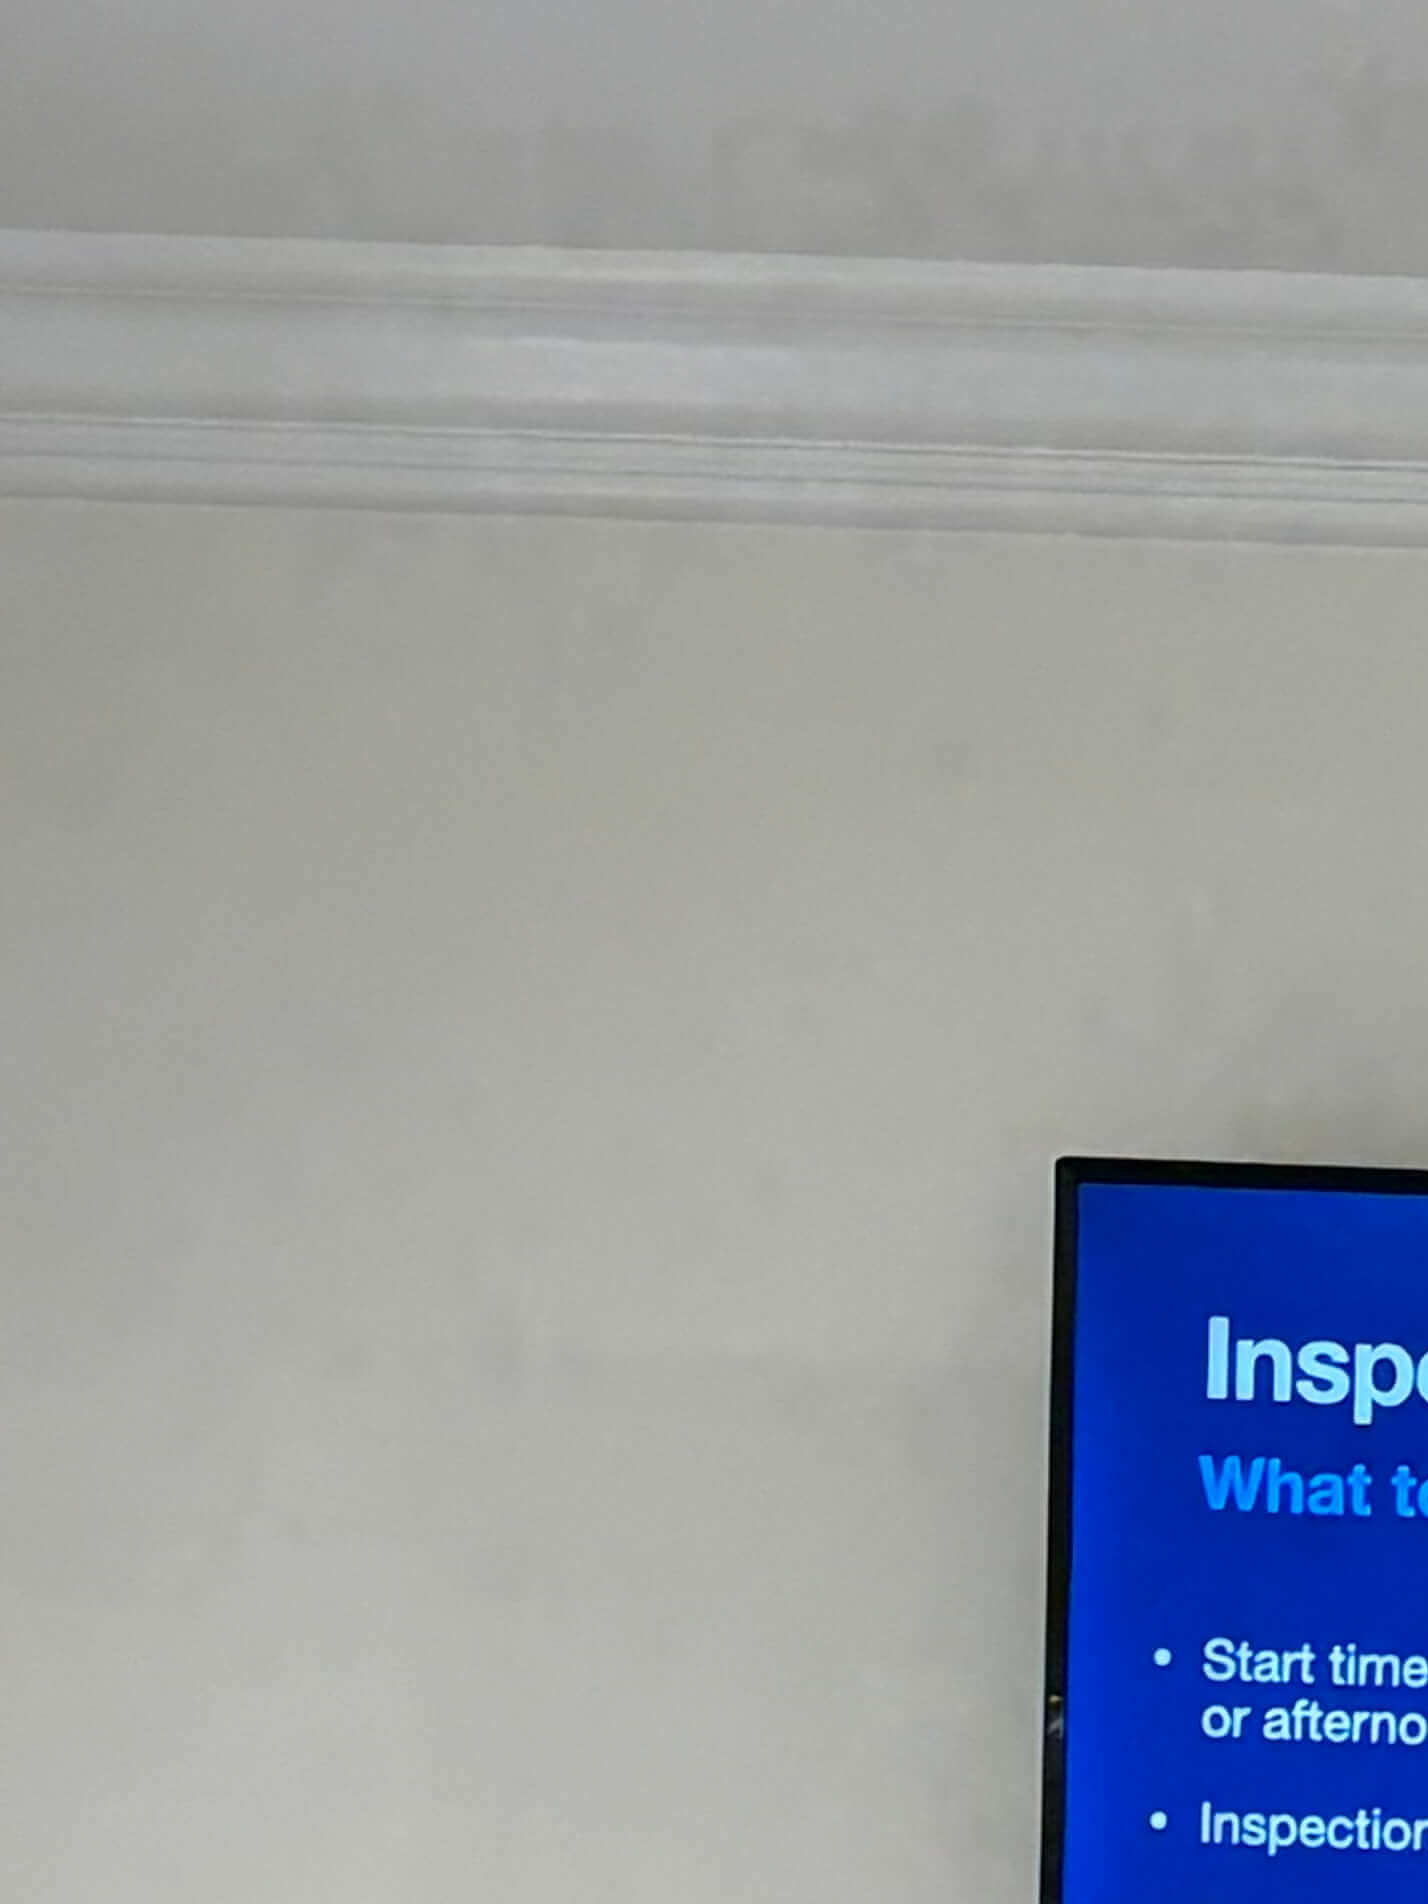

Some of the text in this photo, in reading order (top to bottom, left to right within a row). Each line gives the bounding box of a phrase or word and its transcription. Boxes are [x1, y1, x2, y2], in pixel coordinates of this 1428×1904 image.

[1199, 1456, 1372, 1516] What
[1203, 1637, 1316, 1684] Start
[1202, 1705, 1252, 1738] or
